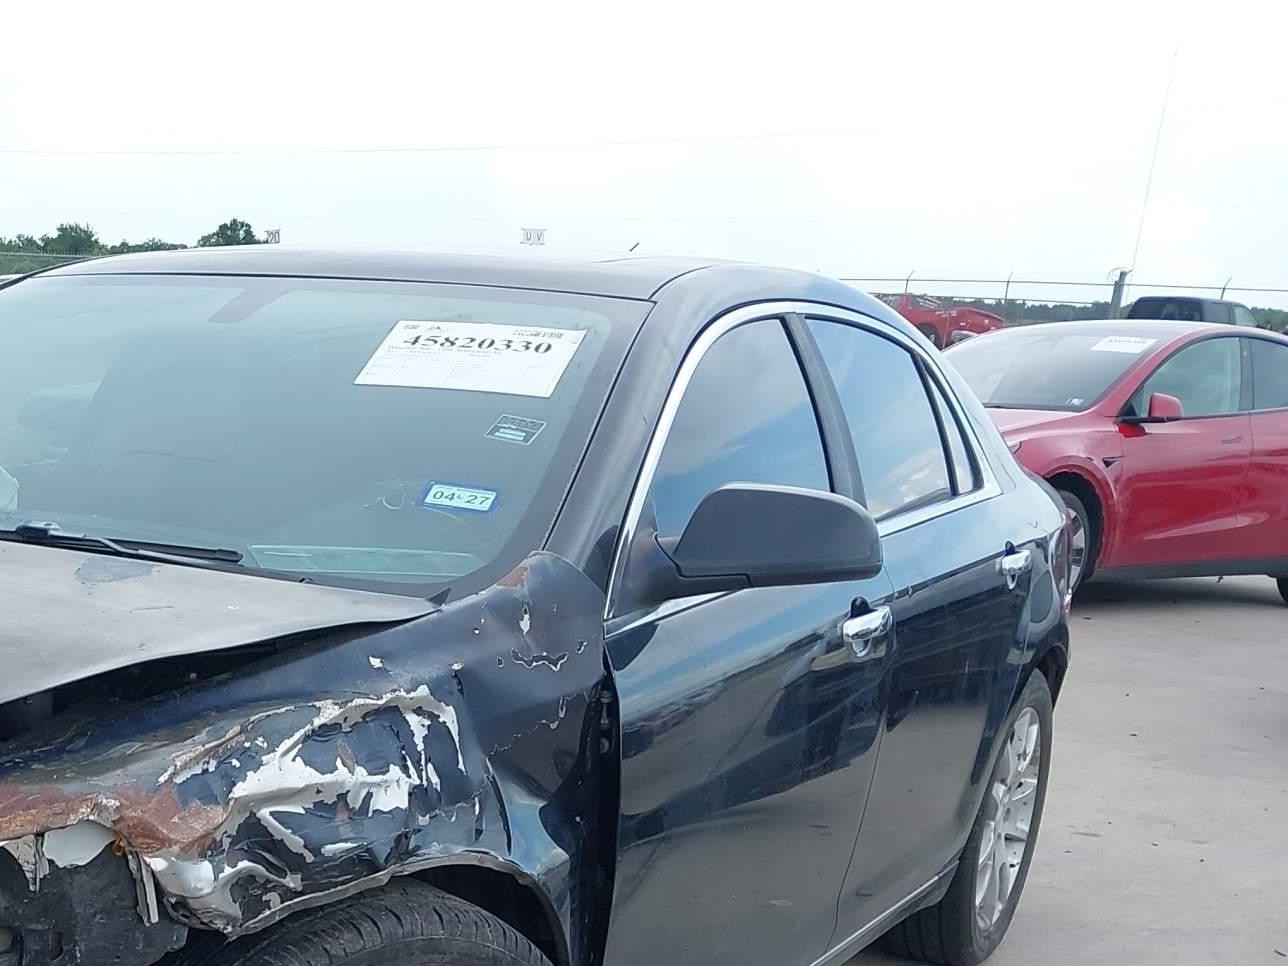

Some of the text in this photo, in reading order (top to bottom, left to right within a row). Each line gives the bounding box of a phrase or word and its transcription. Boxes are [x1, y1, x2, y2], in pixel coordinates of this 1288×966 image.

[403, 335, 552, 354] 45820330
[432, 490, 491, 506] 04 27
